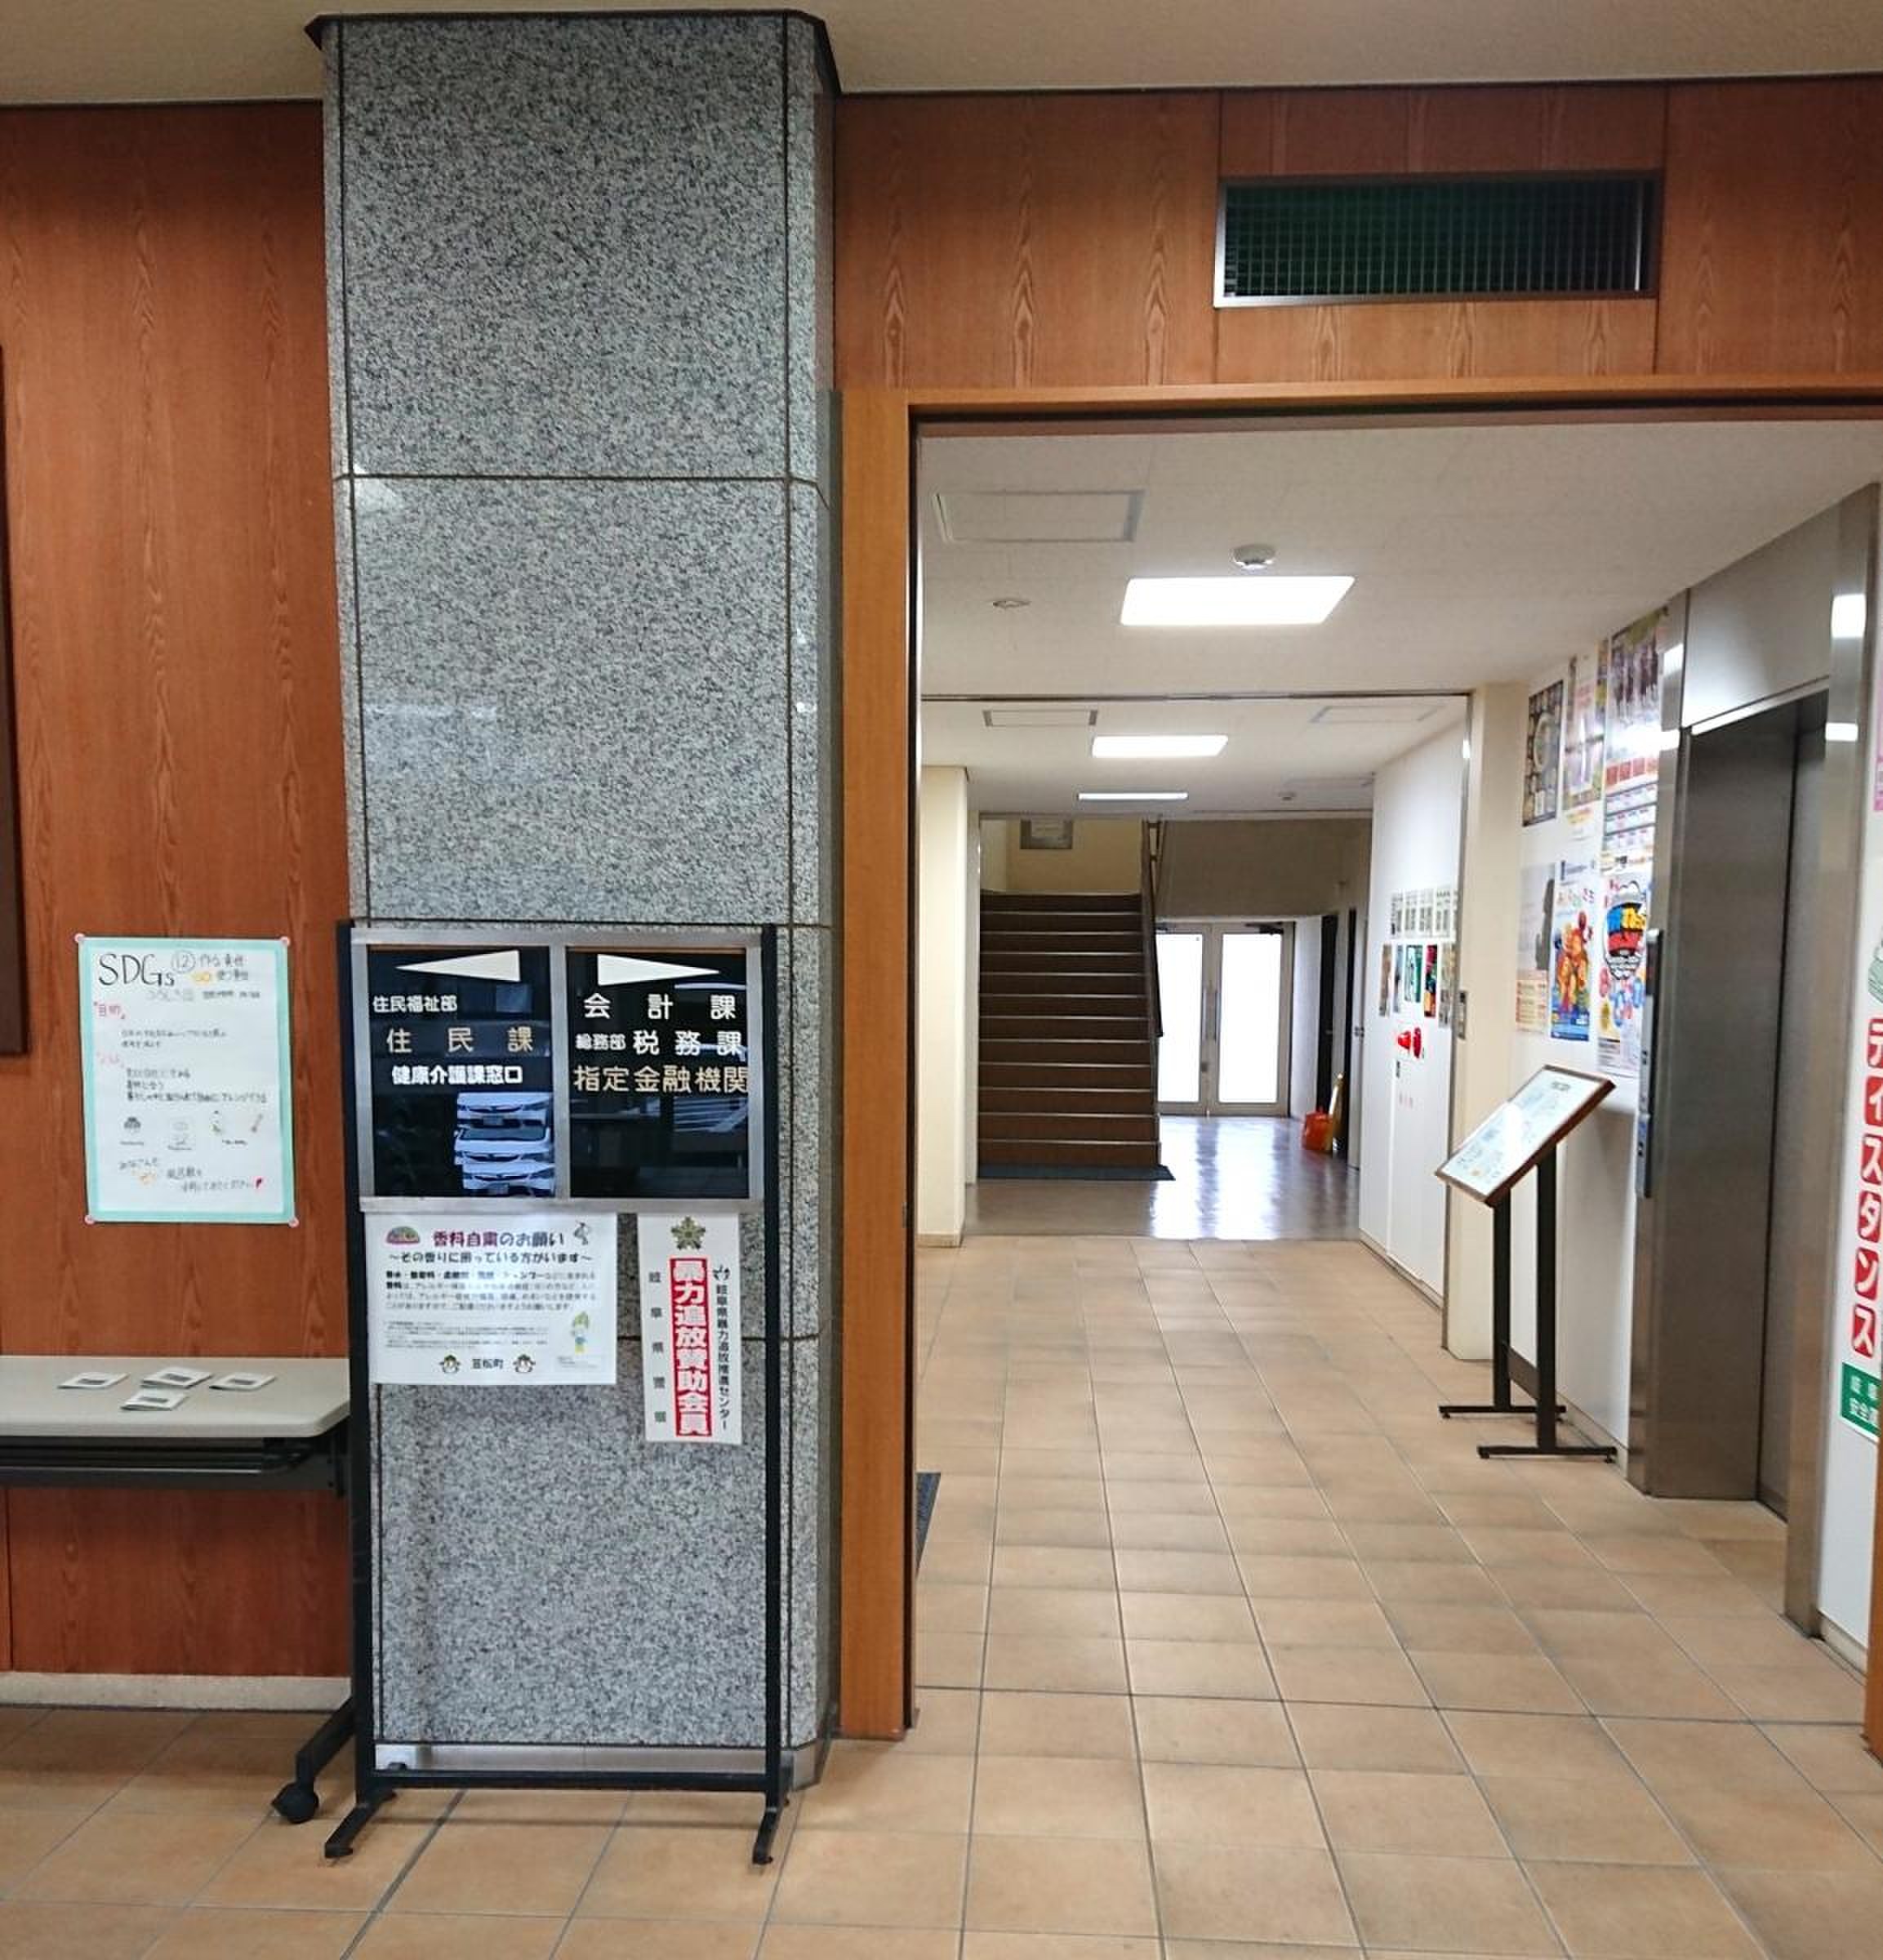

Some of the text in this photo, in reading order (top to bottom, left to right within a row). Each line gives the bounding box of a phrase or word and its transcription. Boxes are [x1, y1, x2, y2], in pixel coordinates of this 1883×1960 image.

[98, 953, 175, 987] SDGs
[372, 995, 457, 1013] 住民福祉部
[584, 992, 736, 1020] 会計課
[386, 1027, 534, 1054] 住民課
[576, 1030, 742, 1056] 総務部 税務課
[392, 1065, 523, 1085] 健康介護課窓口
[573, 1065, 748, 1094] 指定金融機関
